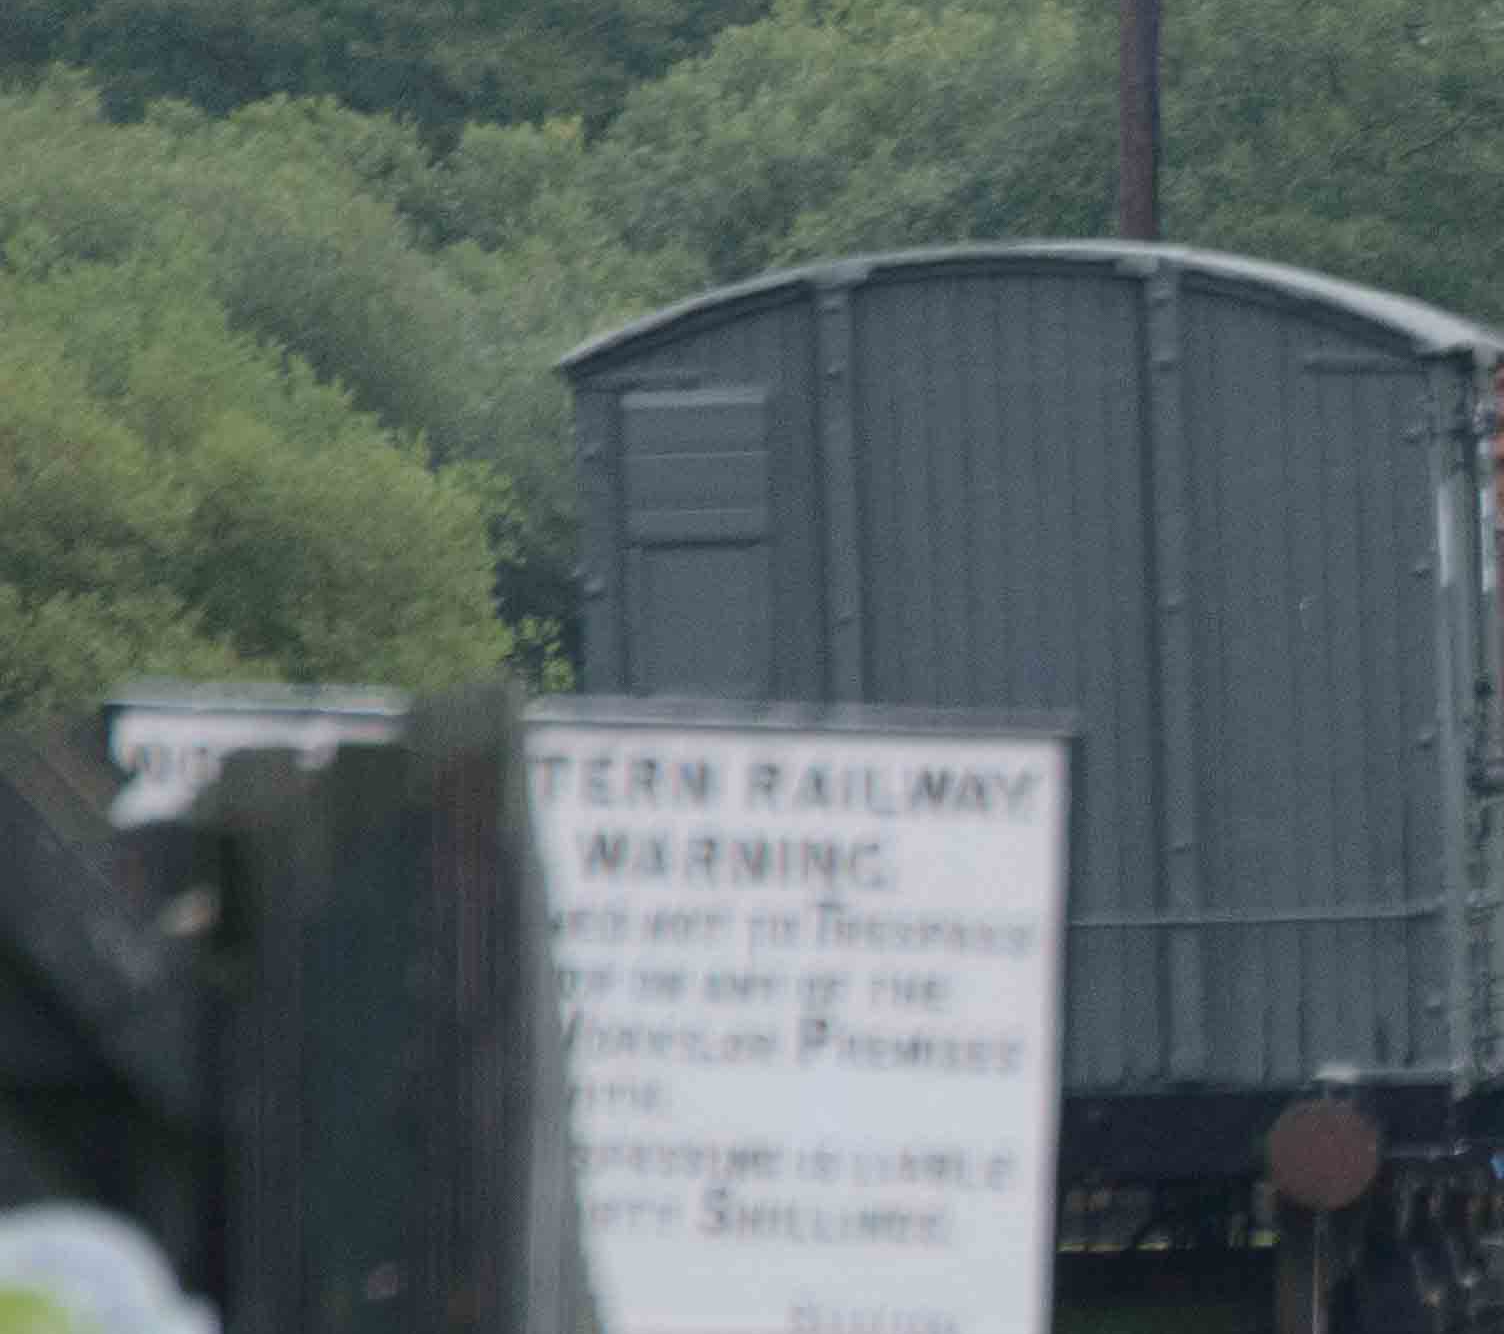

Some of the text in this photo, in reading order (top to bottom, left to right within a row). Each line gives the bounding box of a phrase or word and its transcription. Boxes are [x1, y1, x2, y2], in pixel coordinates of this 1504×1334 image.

[532, 754, 1037, 816] TERN RAILWAY
[581, 831, 889, 889] WARNING
